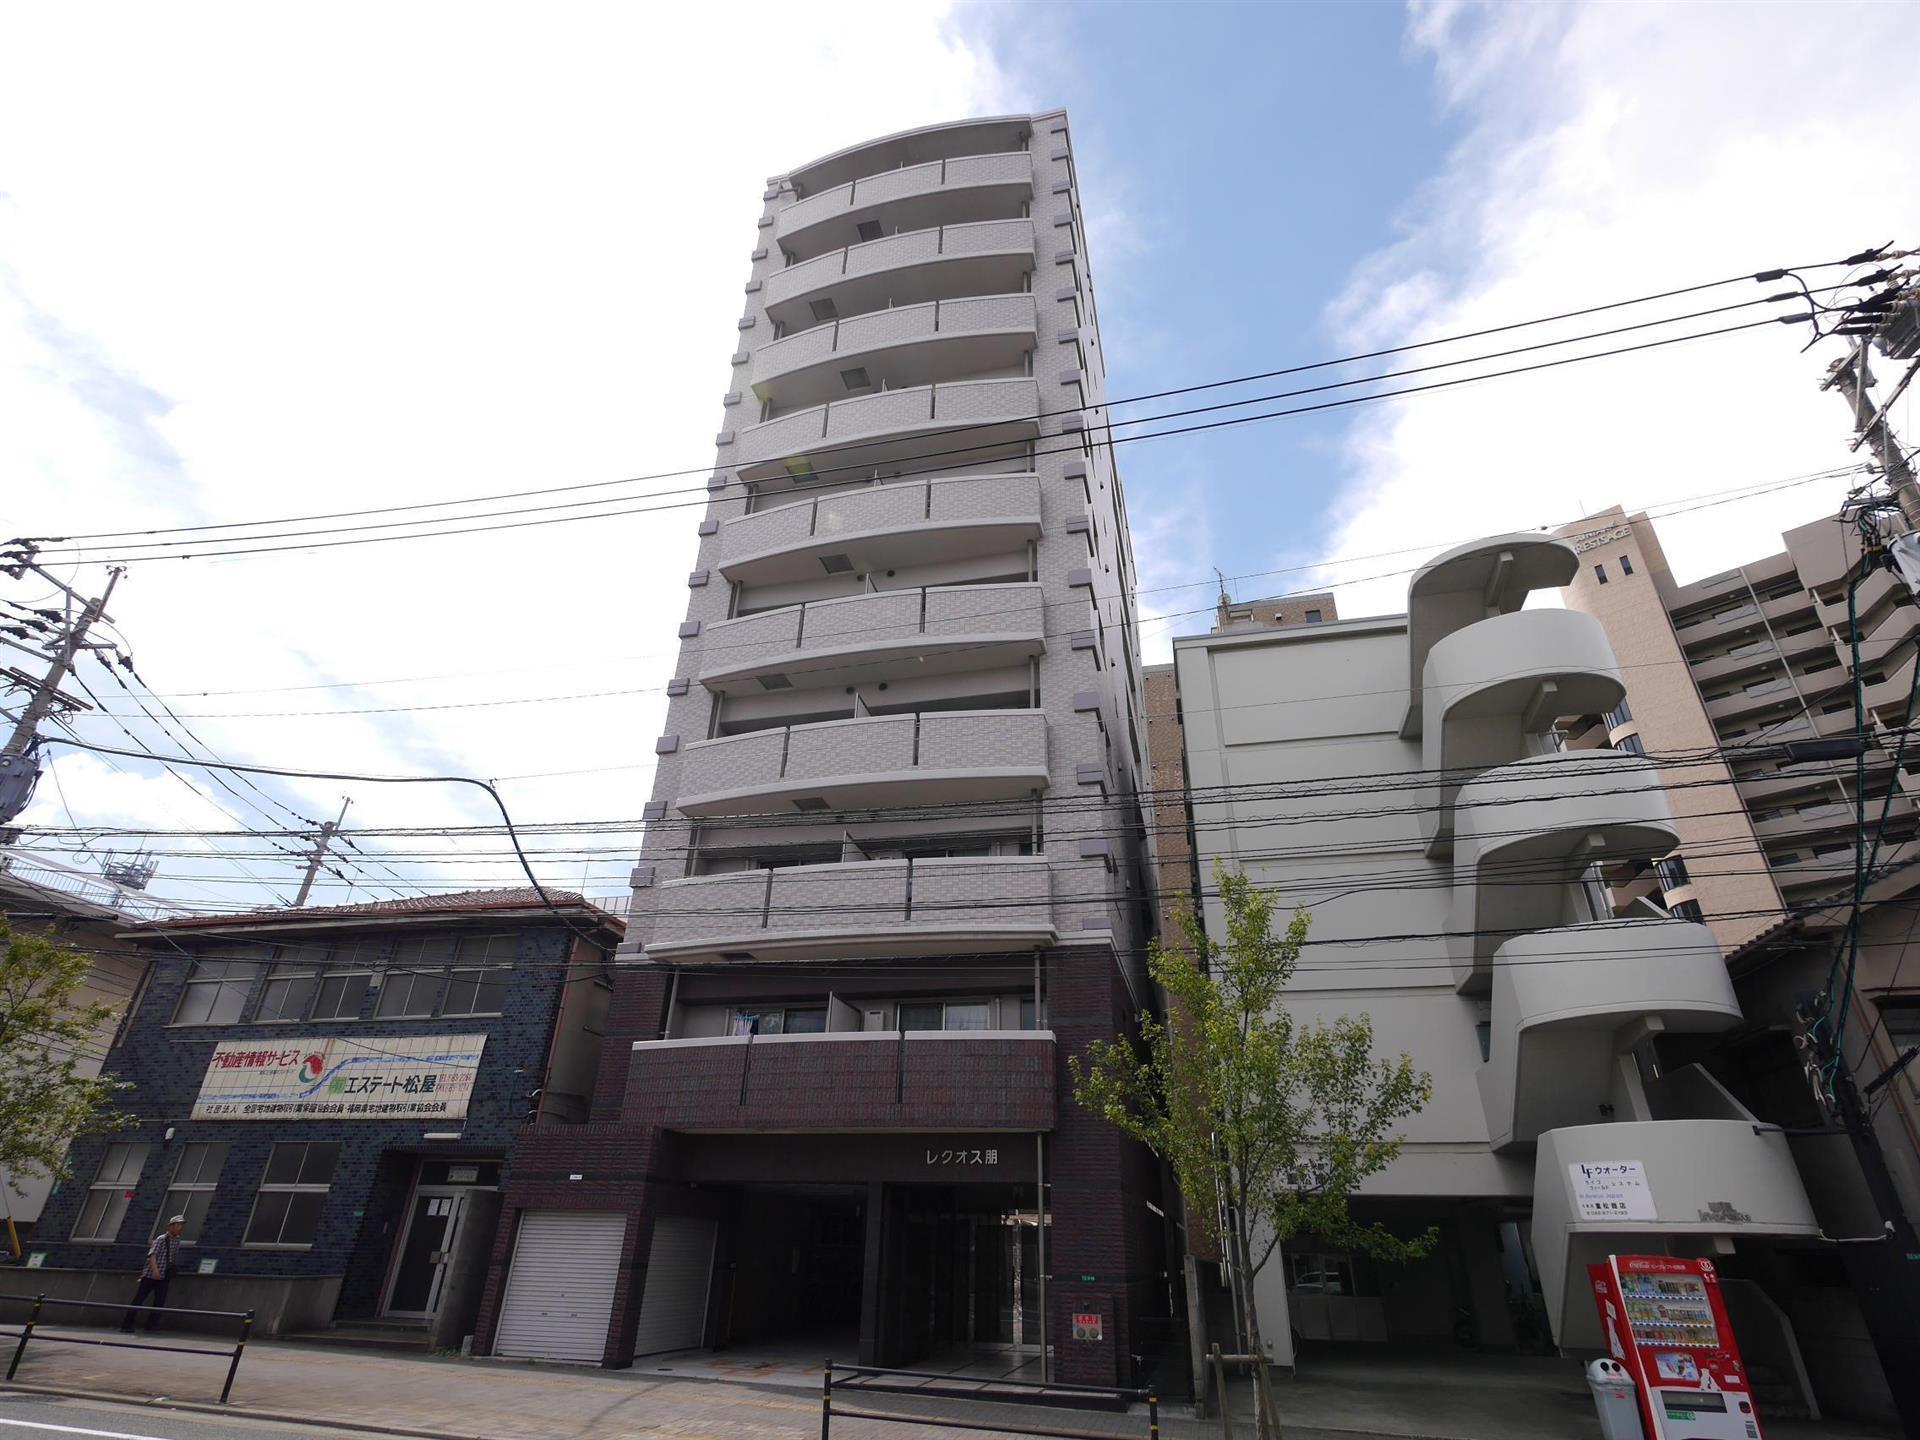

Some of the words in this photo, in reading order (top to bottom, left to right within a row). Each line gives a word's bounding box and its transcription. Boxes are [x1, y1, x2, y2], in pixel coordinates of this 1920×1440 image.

[212, 1049, 301, 1068] 不動産情報サービス
[344, 1074, 438, 1094] エステート松屋
[926, 1149, 998, 1165] レクオス朋
